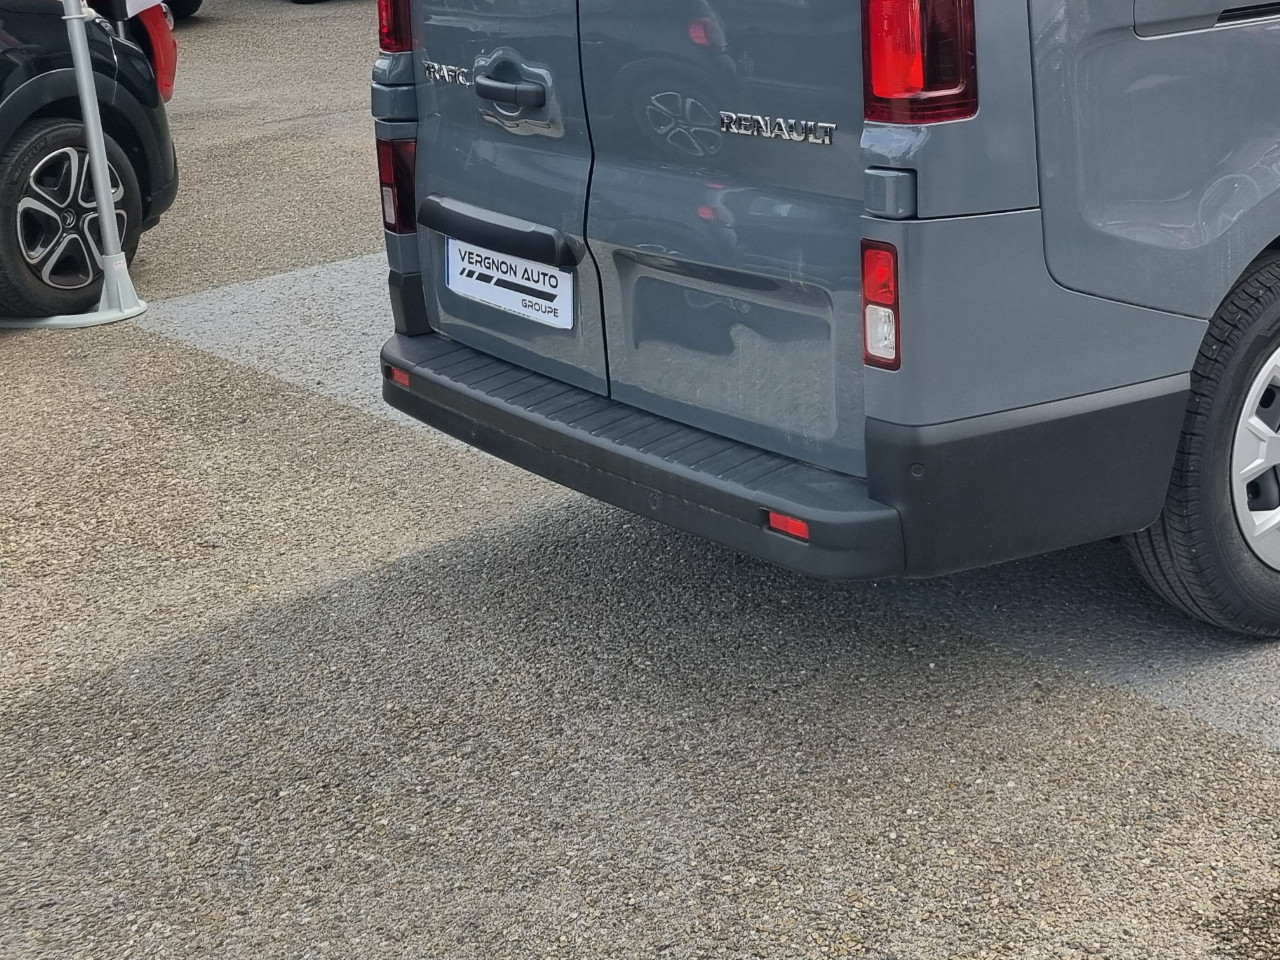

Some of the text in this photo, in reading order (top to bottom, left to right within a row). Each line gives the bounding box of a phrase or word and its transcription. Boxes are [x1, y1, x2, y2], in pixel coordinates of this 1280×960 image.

[422, 60, 472, 87] TRAFIC
[719, 110, 838, 145] RENAULT
[458, 248, 559, 289] VERGNON AUTO
[521, 298, 559, 318] GROUPE
